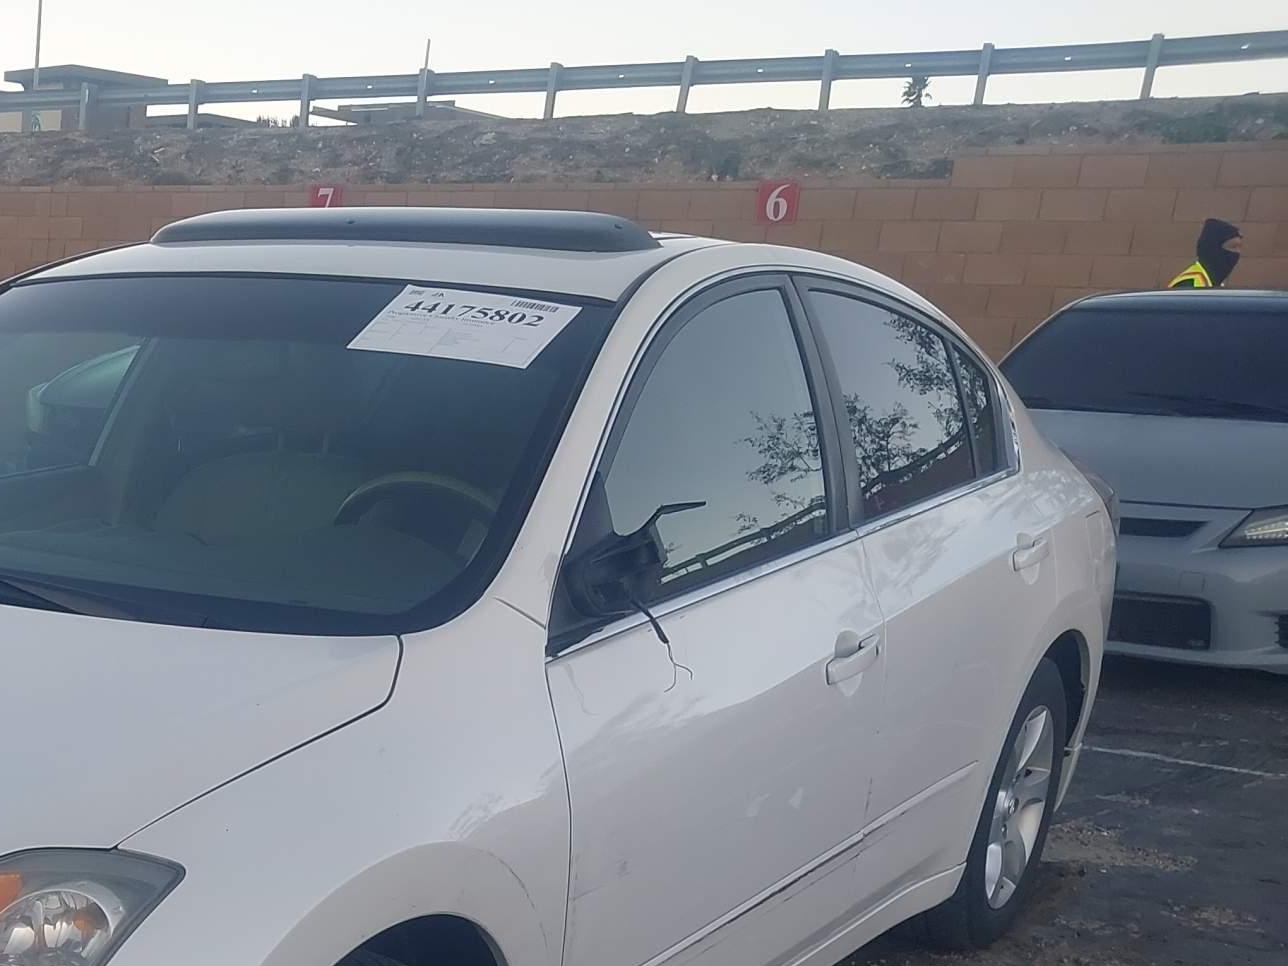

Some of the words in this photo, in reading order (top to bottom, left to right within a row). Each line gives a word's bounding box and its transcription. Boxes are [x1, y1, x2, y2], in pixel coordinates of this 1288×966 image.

[317, 187, 335, 208] 7
[765, 183, 791, 222] 6
[404, 300, 544, 327] 44175802
